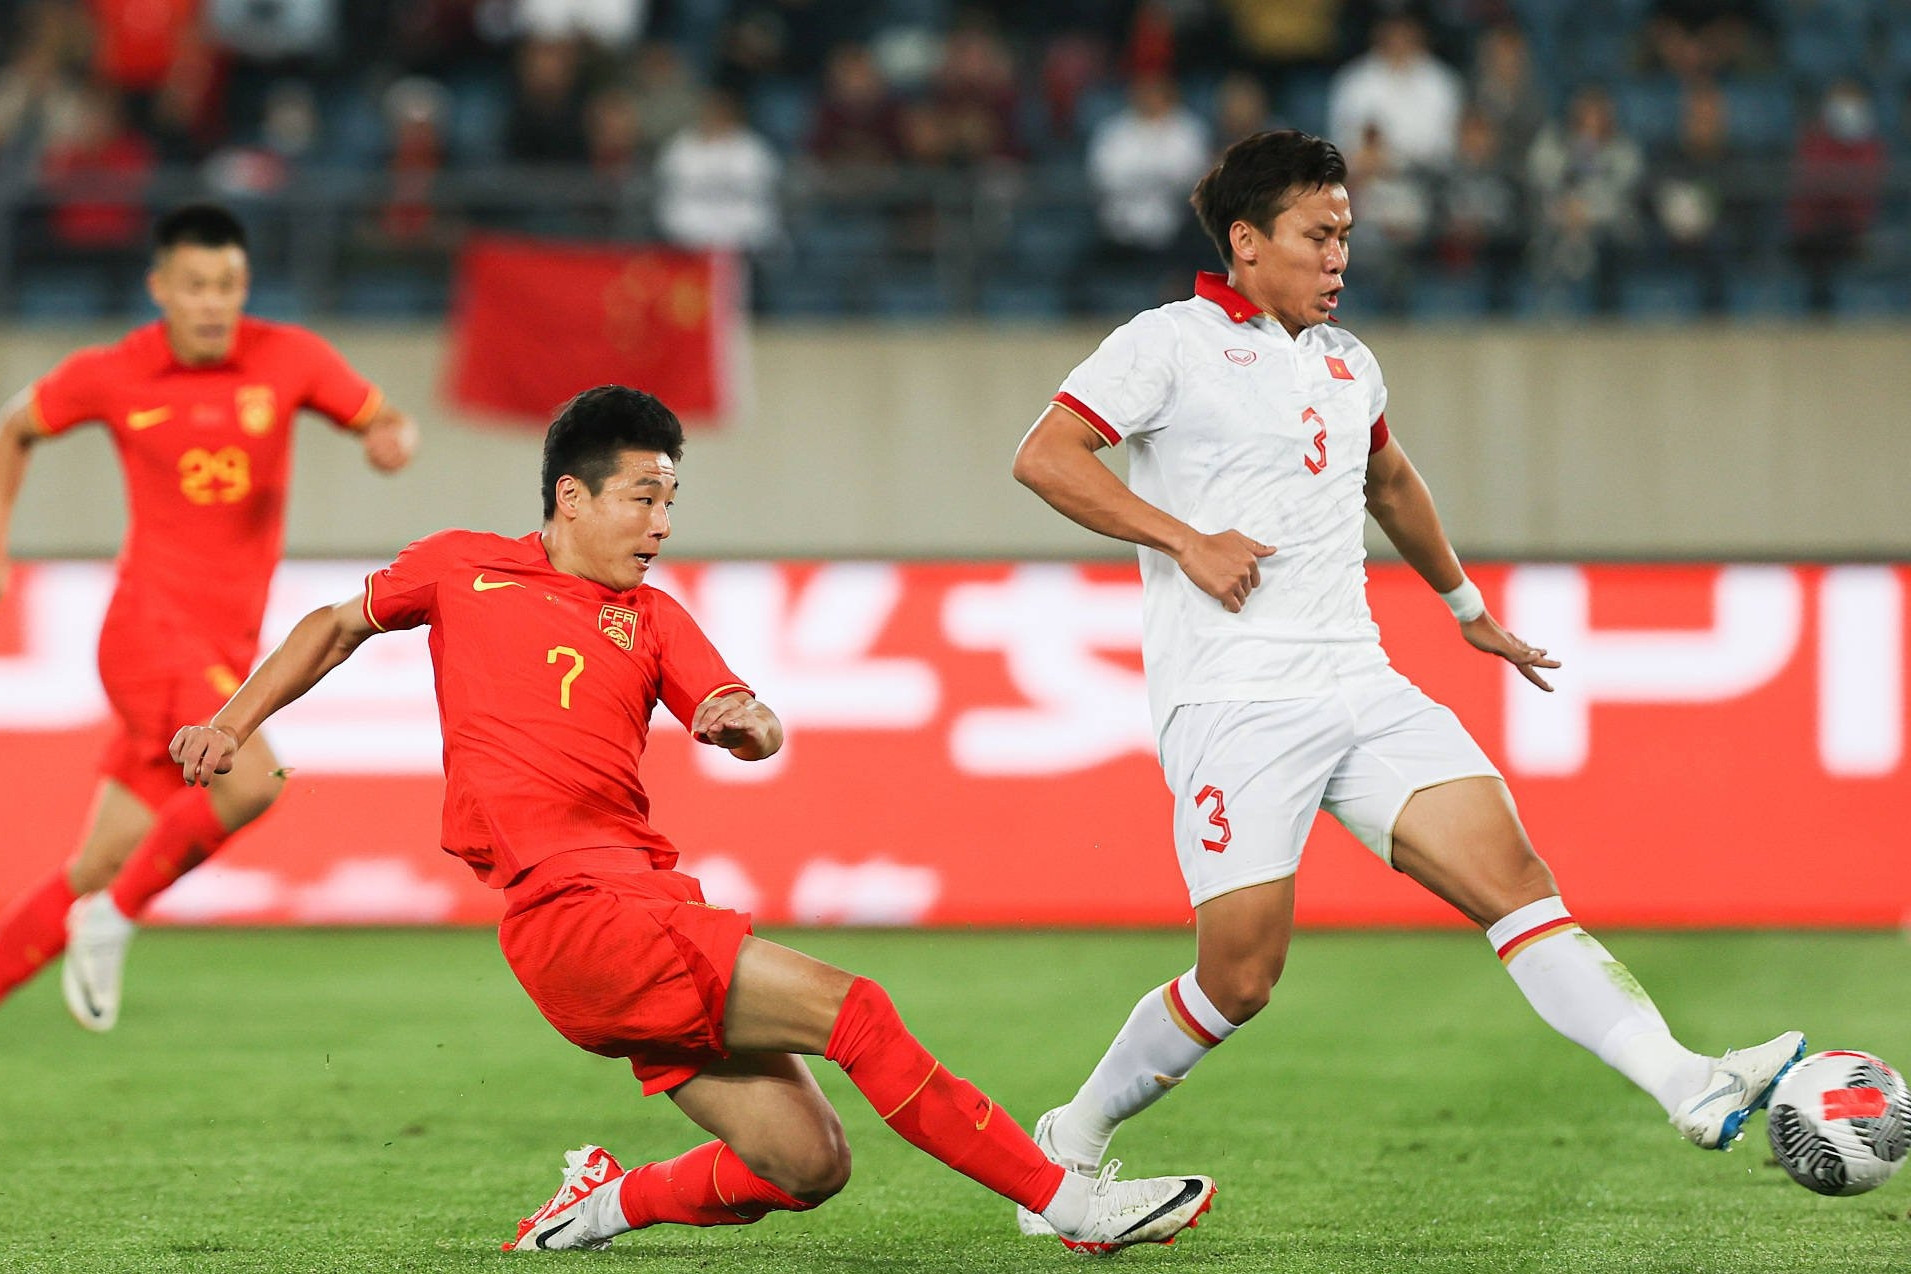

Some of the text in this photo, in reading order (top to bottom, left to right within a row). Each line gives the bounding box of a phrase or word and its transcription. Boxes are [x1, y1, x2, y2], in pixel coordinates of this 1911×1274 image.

[1301, 407, 1327, 475] 3
[178, 447, 251, 505] 29
[602, 608, 634, 624] CFA
[547, 645, 584, 709] 7
[1194, 784, 1232, 853] 3
